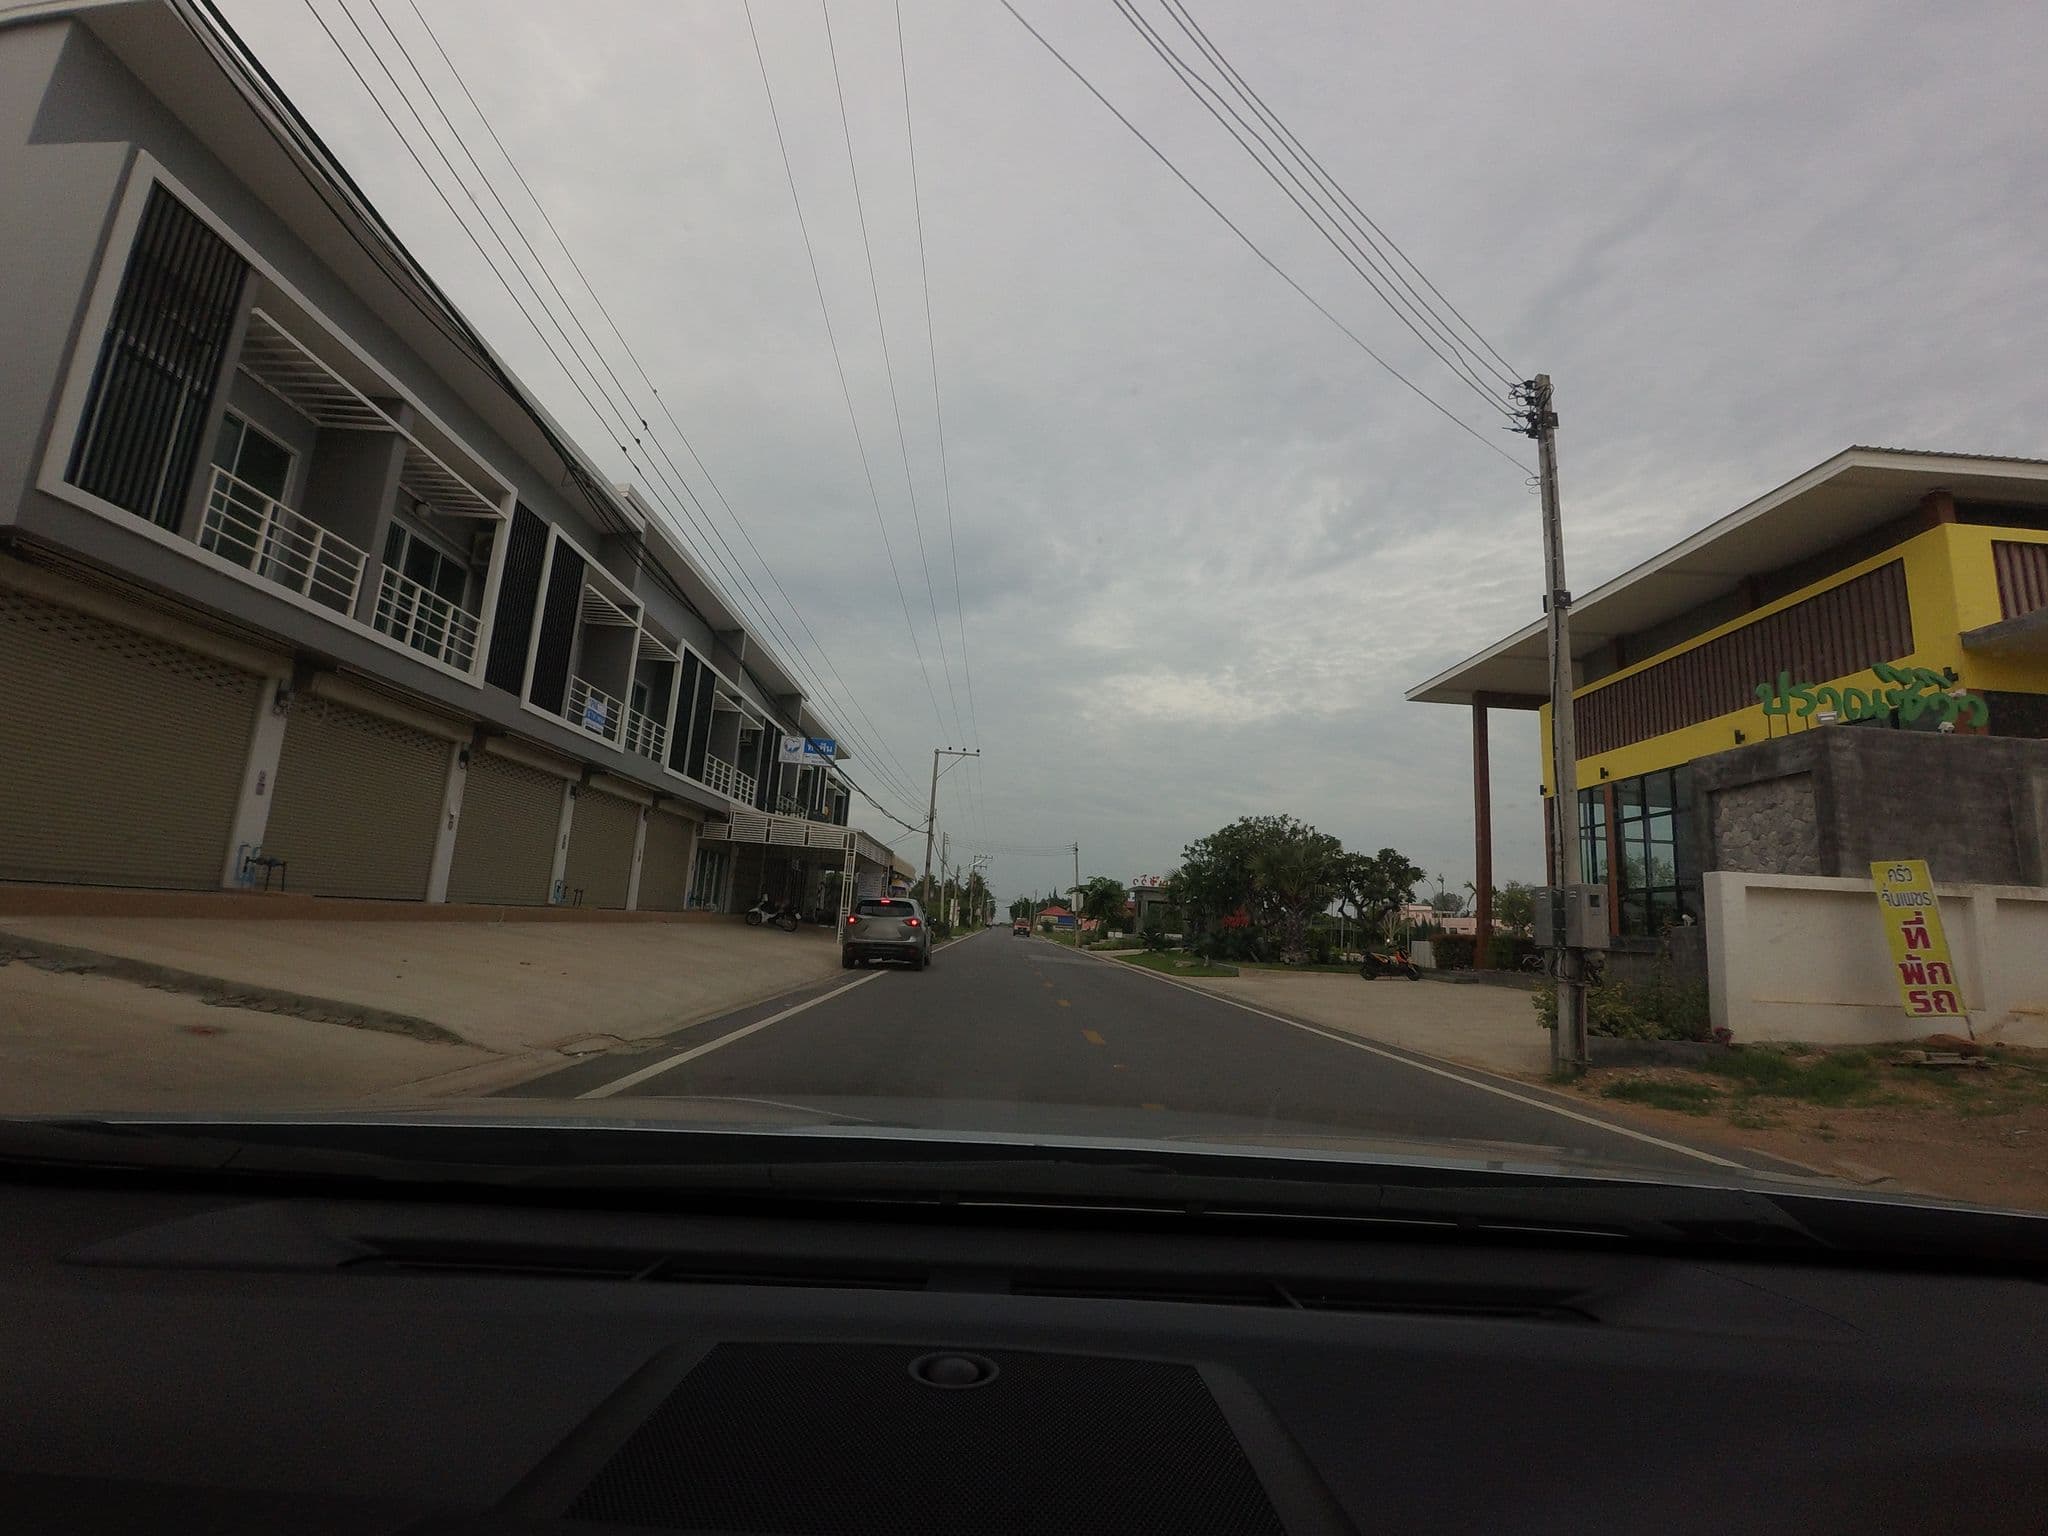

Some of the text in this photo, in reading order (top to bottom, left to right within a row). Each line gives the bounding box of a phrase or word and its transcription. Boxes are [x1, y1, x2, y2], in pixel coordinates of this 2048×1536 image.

[1901, 911, 1931, 949] ที่
[1898, 954, 1952, 985] พัก
[1908, 990, 1959, 1013] รถ
